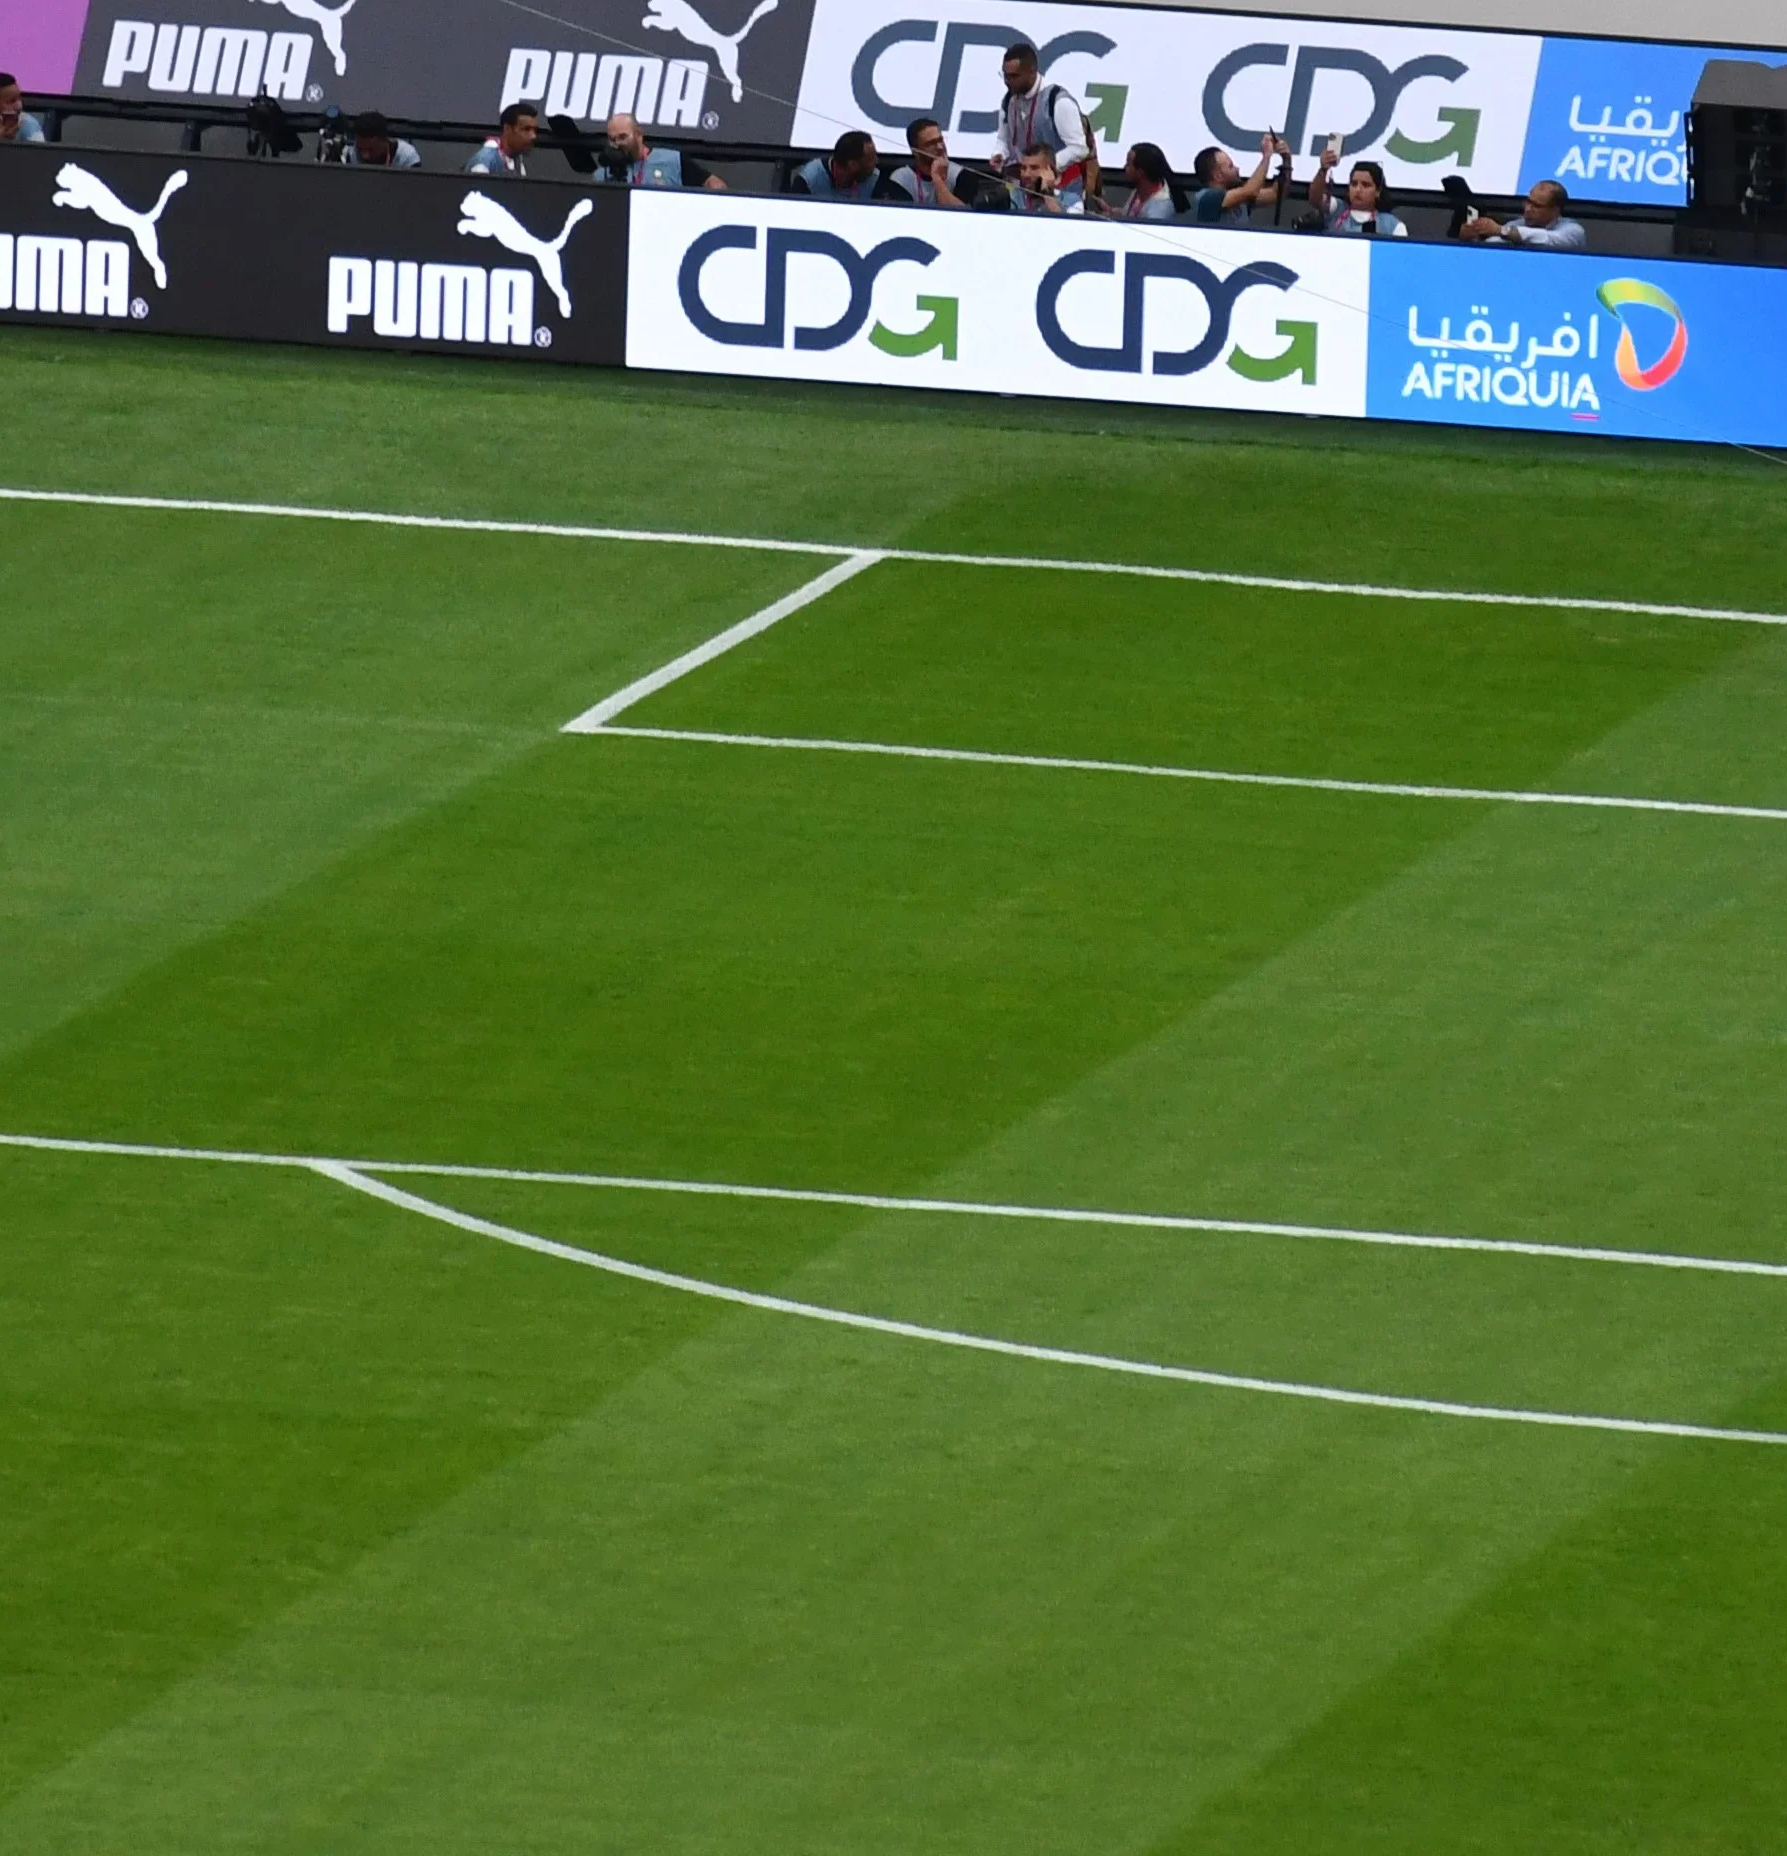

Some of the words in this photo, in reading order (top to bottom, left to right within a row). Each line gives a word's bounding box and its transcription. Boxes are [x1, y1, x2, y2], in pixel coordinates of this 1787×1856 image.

[102, 18, 315, 101] PUMA
[500, 46, 708, 129] PUMA
[851, 19, 1129, 143] CDG
[1201, 42, 1481, 166] CDG
[1554, 144, 1689, 186] AFRIQ
[327, 255, 537, 346] PUMA
[677, 224, 959, 361] CDG
[1035, 248, 1318, 386] CDG
[1407, 304, 1599, 365] افريقيا
[1401, 361, 1600, 411] AFRIQUIA
